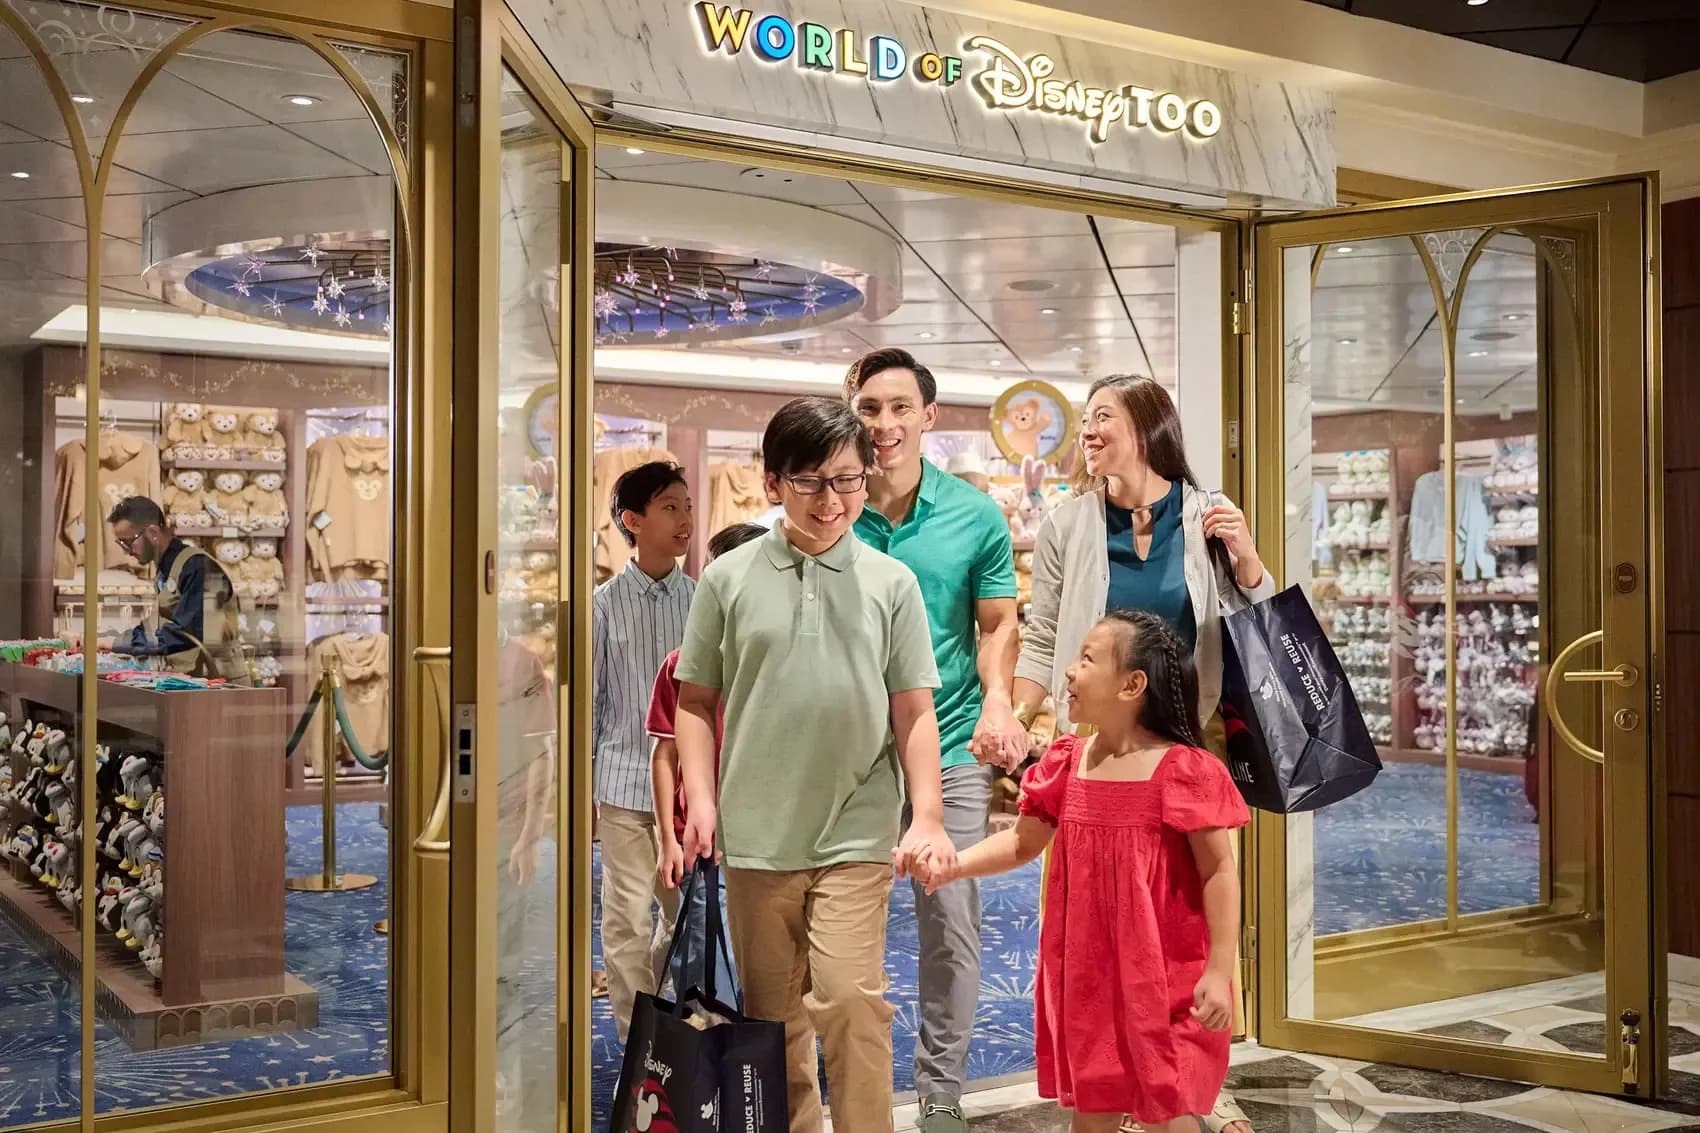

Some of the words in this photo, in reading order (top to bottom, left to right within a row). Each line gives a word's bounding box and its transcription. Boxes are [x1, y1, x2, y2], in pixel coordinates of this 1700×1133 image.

[696, 2, 907, 82] WORLD
[913, 53, 962, 84] OF
[963, 36, 1124, 143] Disney
[1122, 85, 1221, 138] TOO
[1280, 633, 1302, 664] REUSE
[1301, 673, 1326, 711] REDUCE
[743, 1064, 752, 1093] REUSE
[745, 1105, 755, 1133] EDUCE
